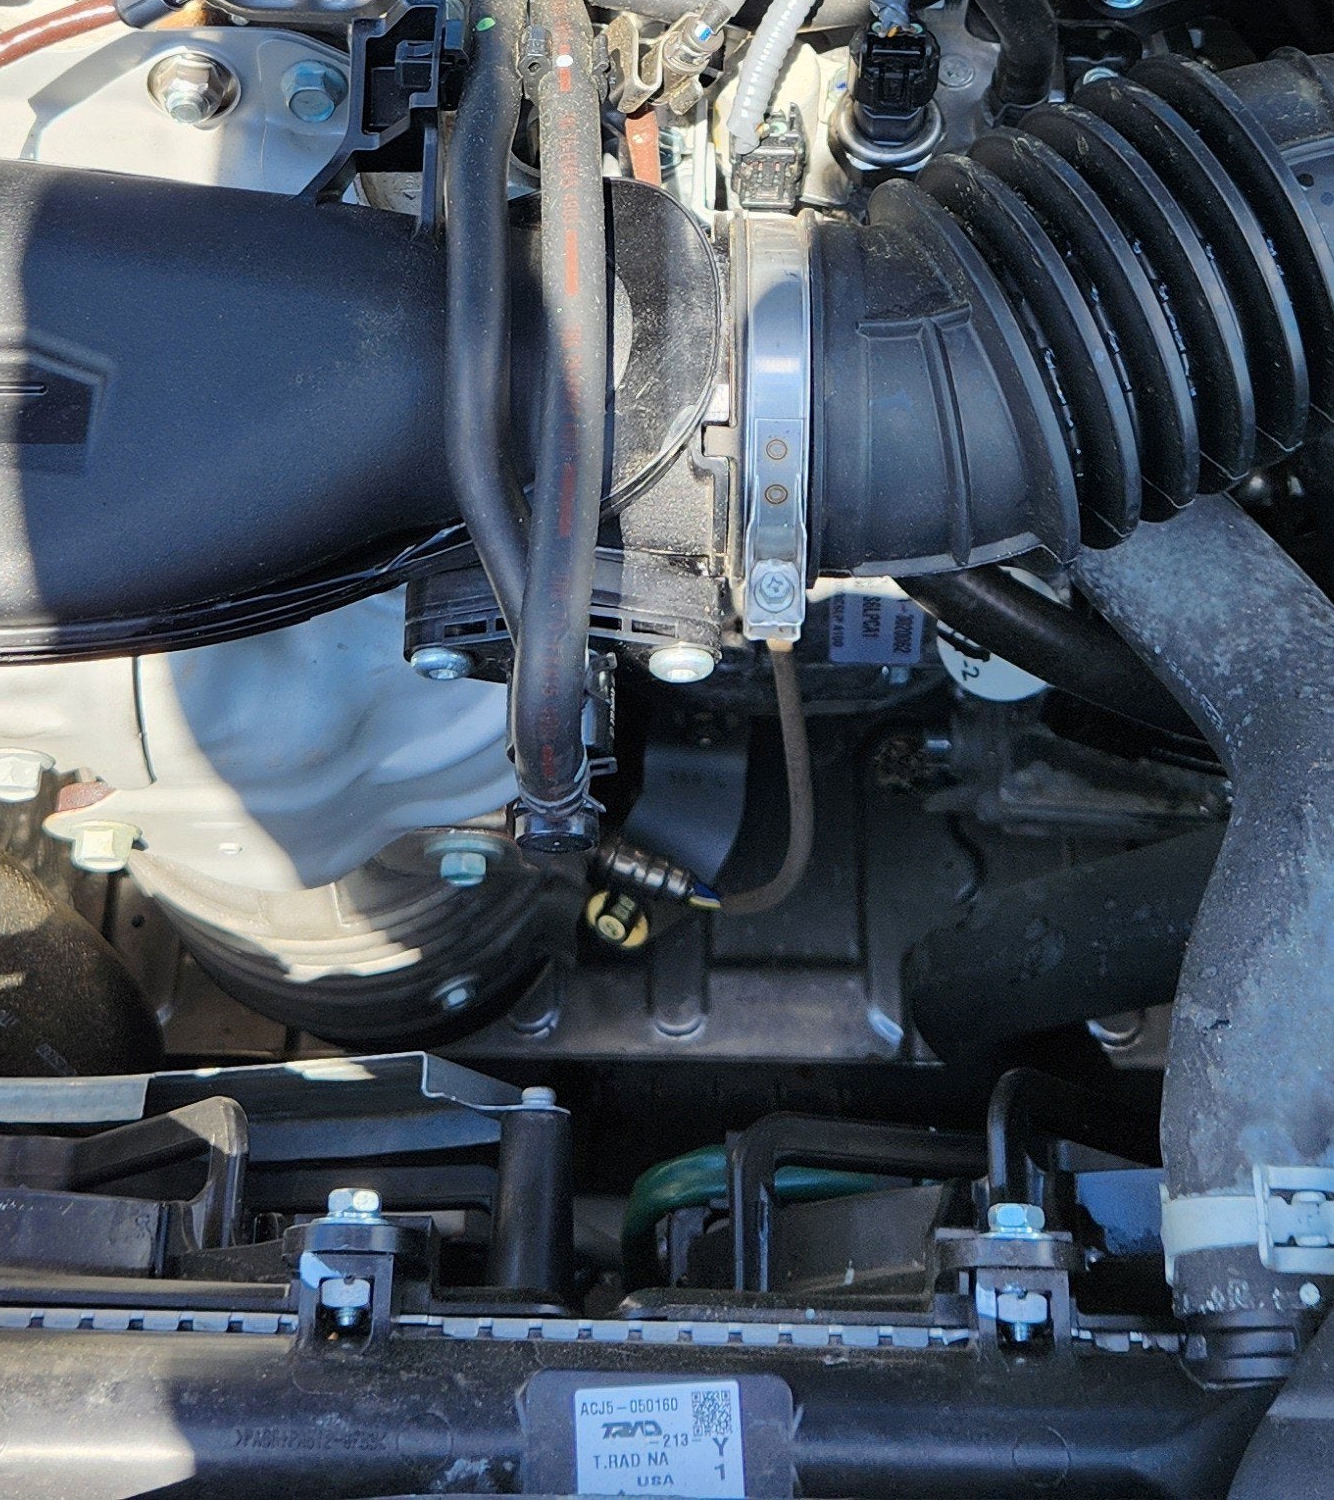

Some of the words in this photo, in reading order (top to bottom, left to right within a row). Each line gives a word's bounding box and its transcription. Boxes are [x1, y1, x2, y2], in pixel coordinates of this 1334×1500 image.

[712, 1437, 729, 1457] Y
[593, 1453, 641, 1470] T.RAD
[647, 1452, 669, 1467] NA
[714, 1463, 726, 1481] 1
[637, 1475, 675, 1488] USA
